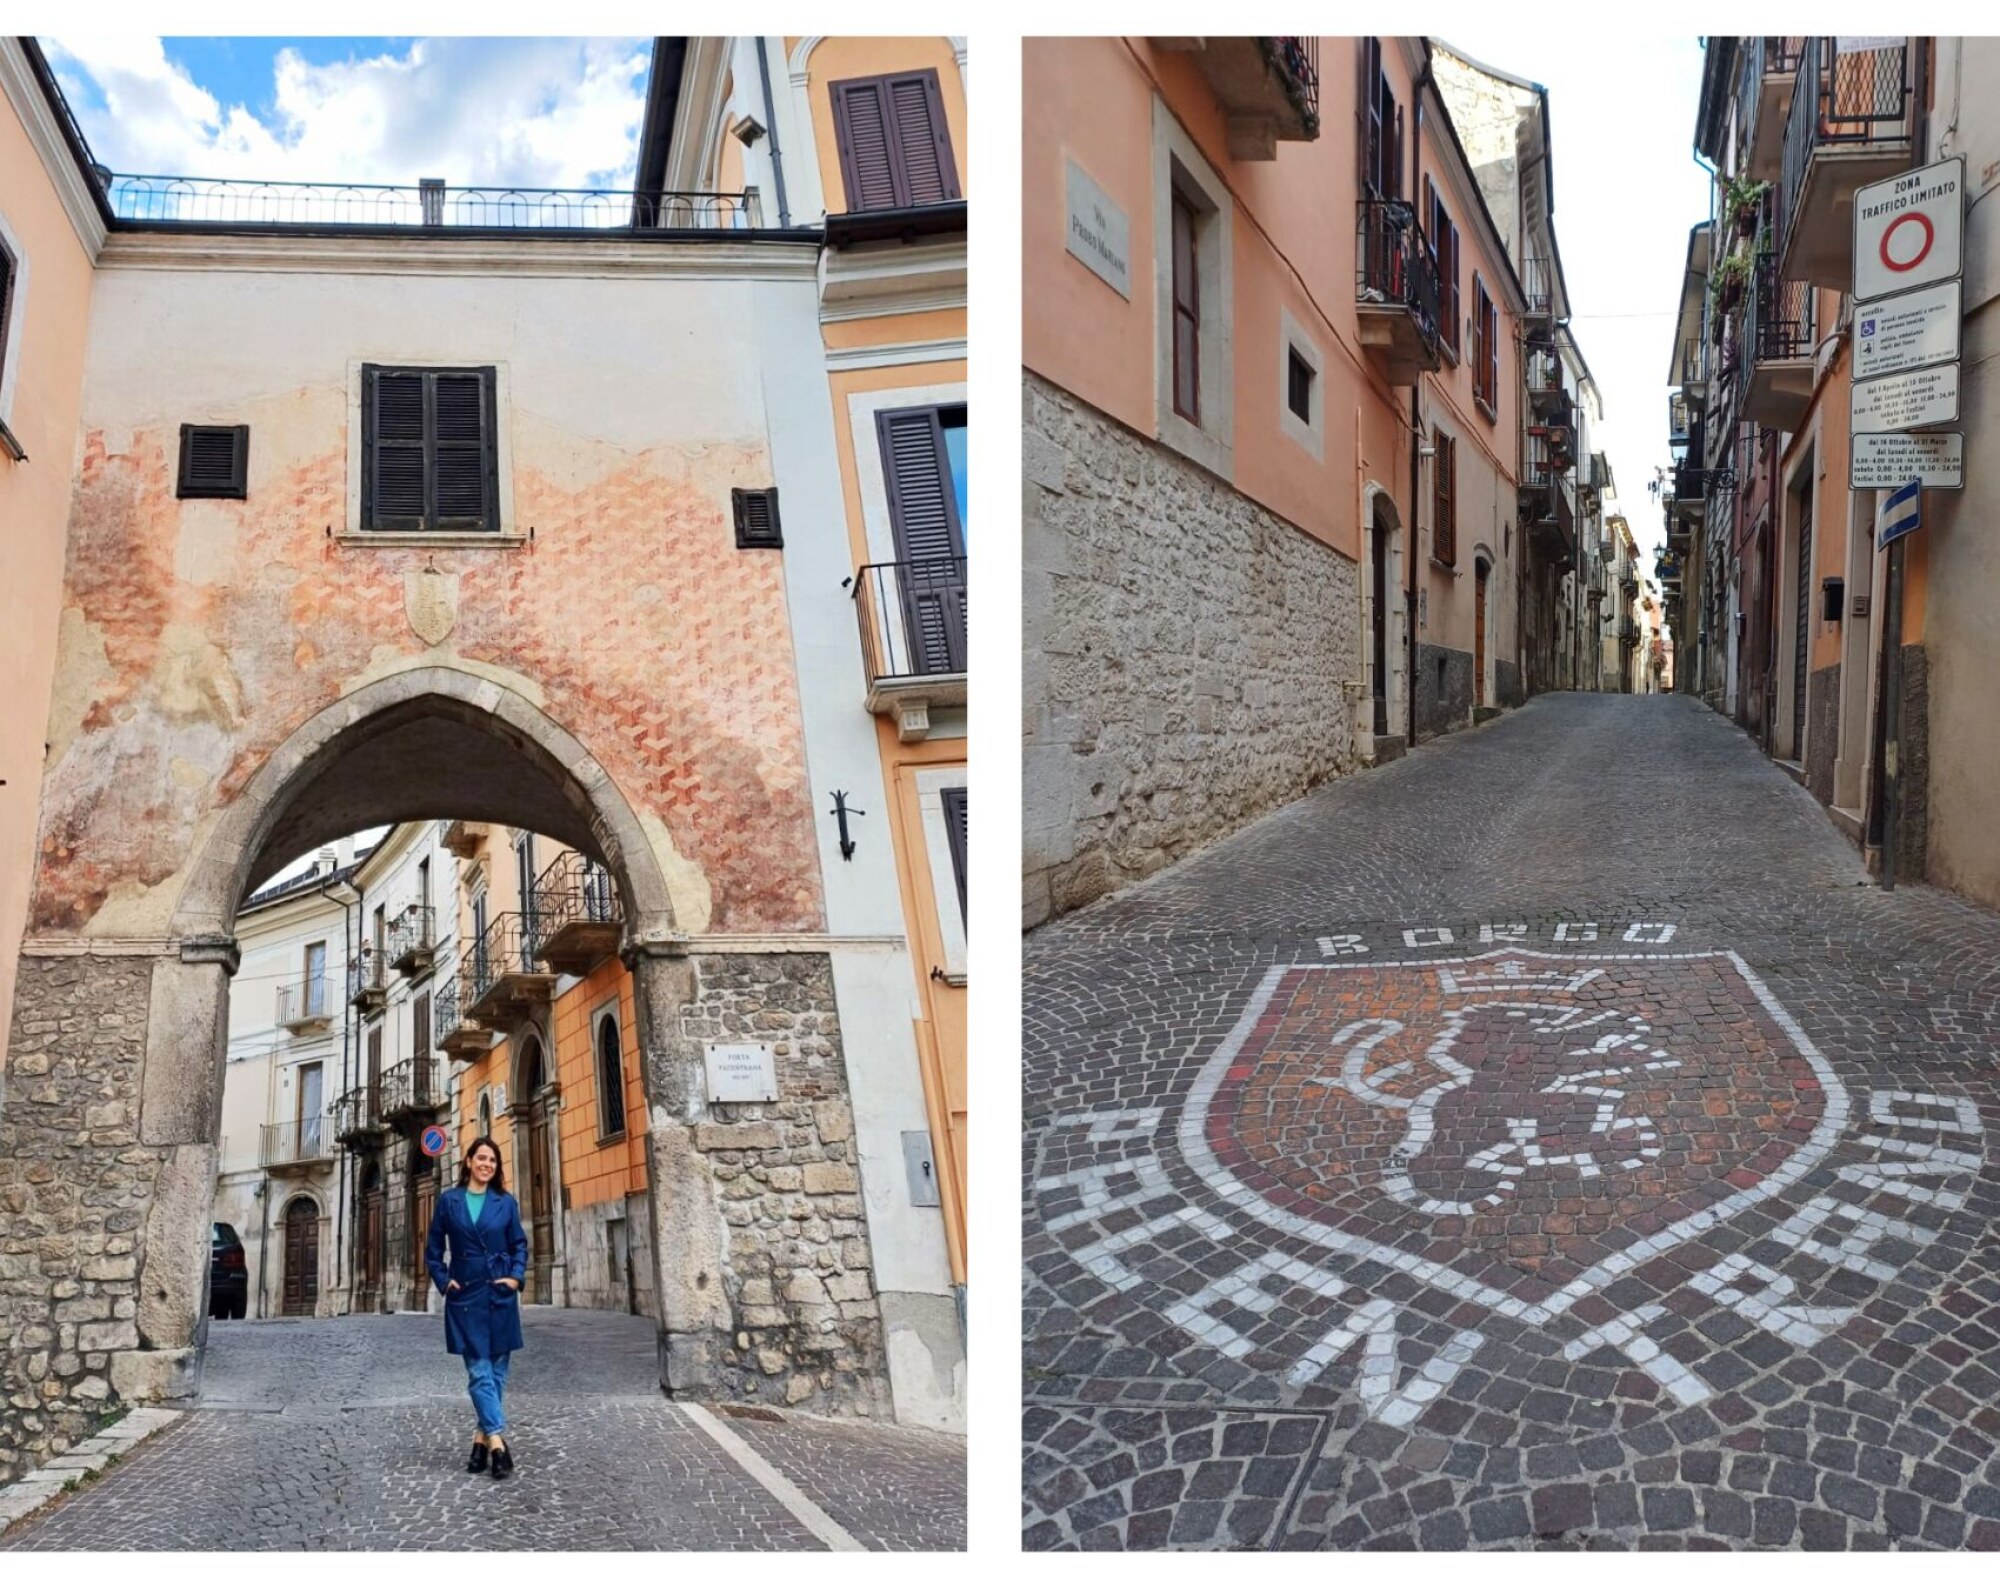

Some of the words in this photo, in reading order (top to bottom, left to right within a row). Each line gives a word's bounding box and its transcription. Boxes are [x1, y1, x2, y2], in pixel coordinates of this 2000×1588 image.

[1894, 176, 1920, 194] ZONA
[1862, 197, 1907, 220] TRAFFICO
[1910, 181, 1955, 205] LIMITATO
[1919, 374, 1941, 384] Ottobre
[1888, 438, 1912, 446] Ottobre
[1913, 438, 1920, 446] al
[1930, 438, 1948, 446] Marzo
[1876, 447, 1887, 455] dal
[1908, 447, 1915, 455] al
[1315, 923, 1677, 957] BORGO
